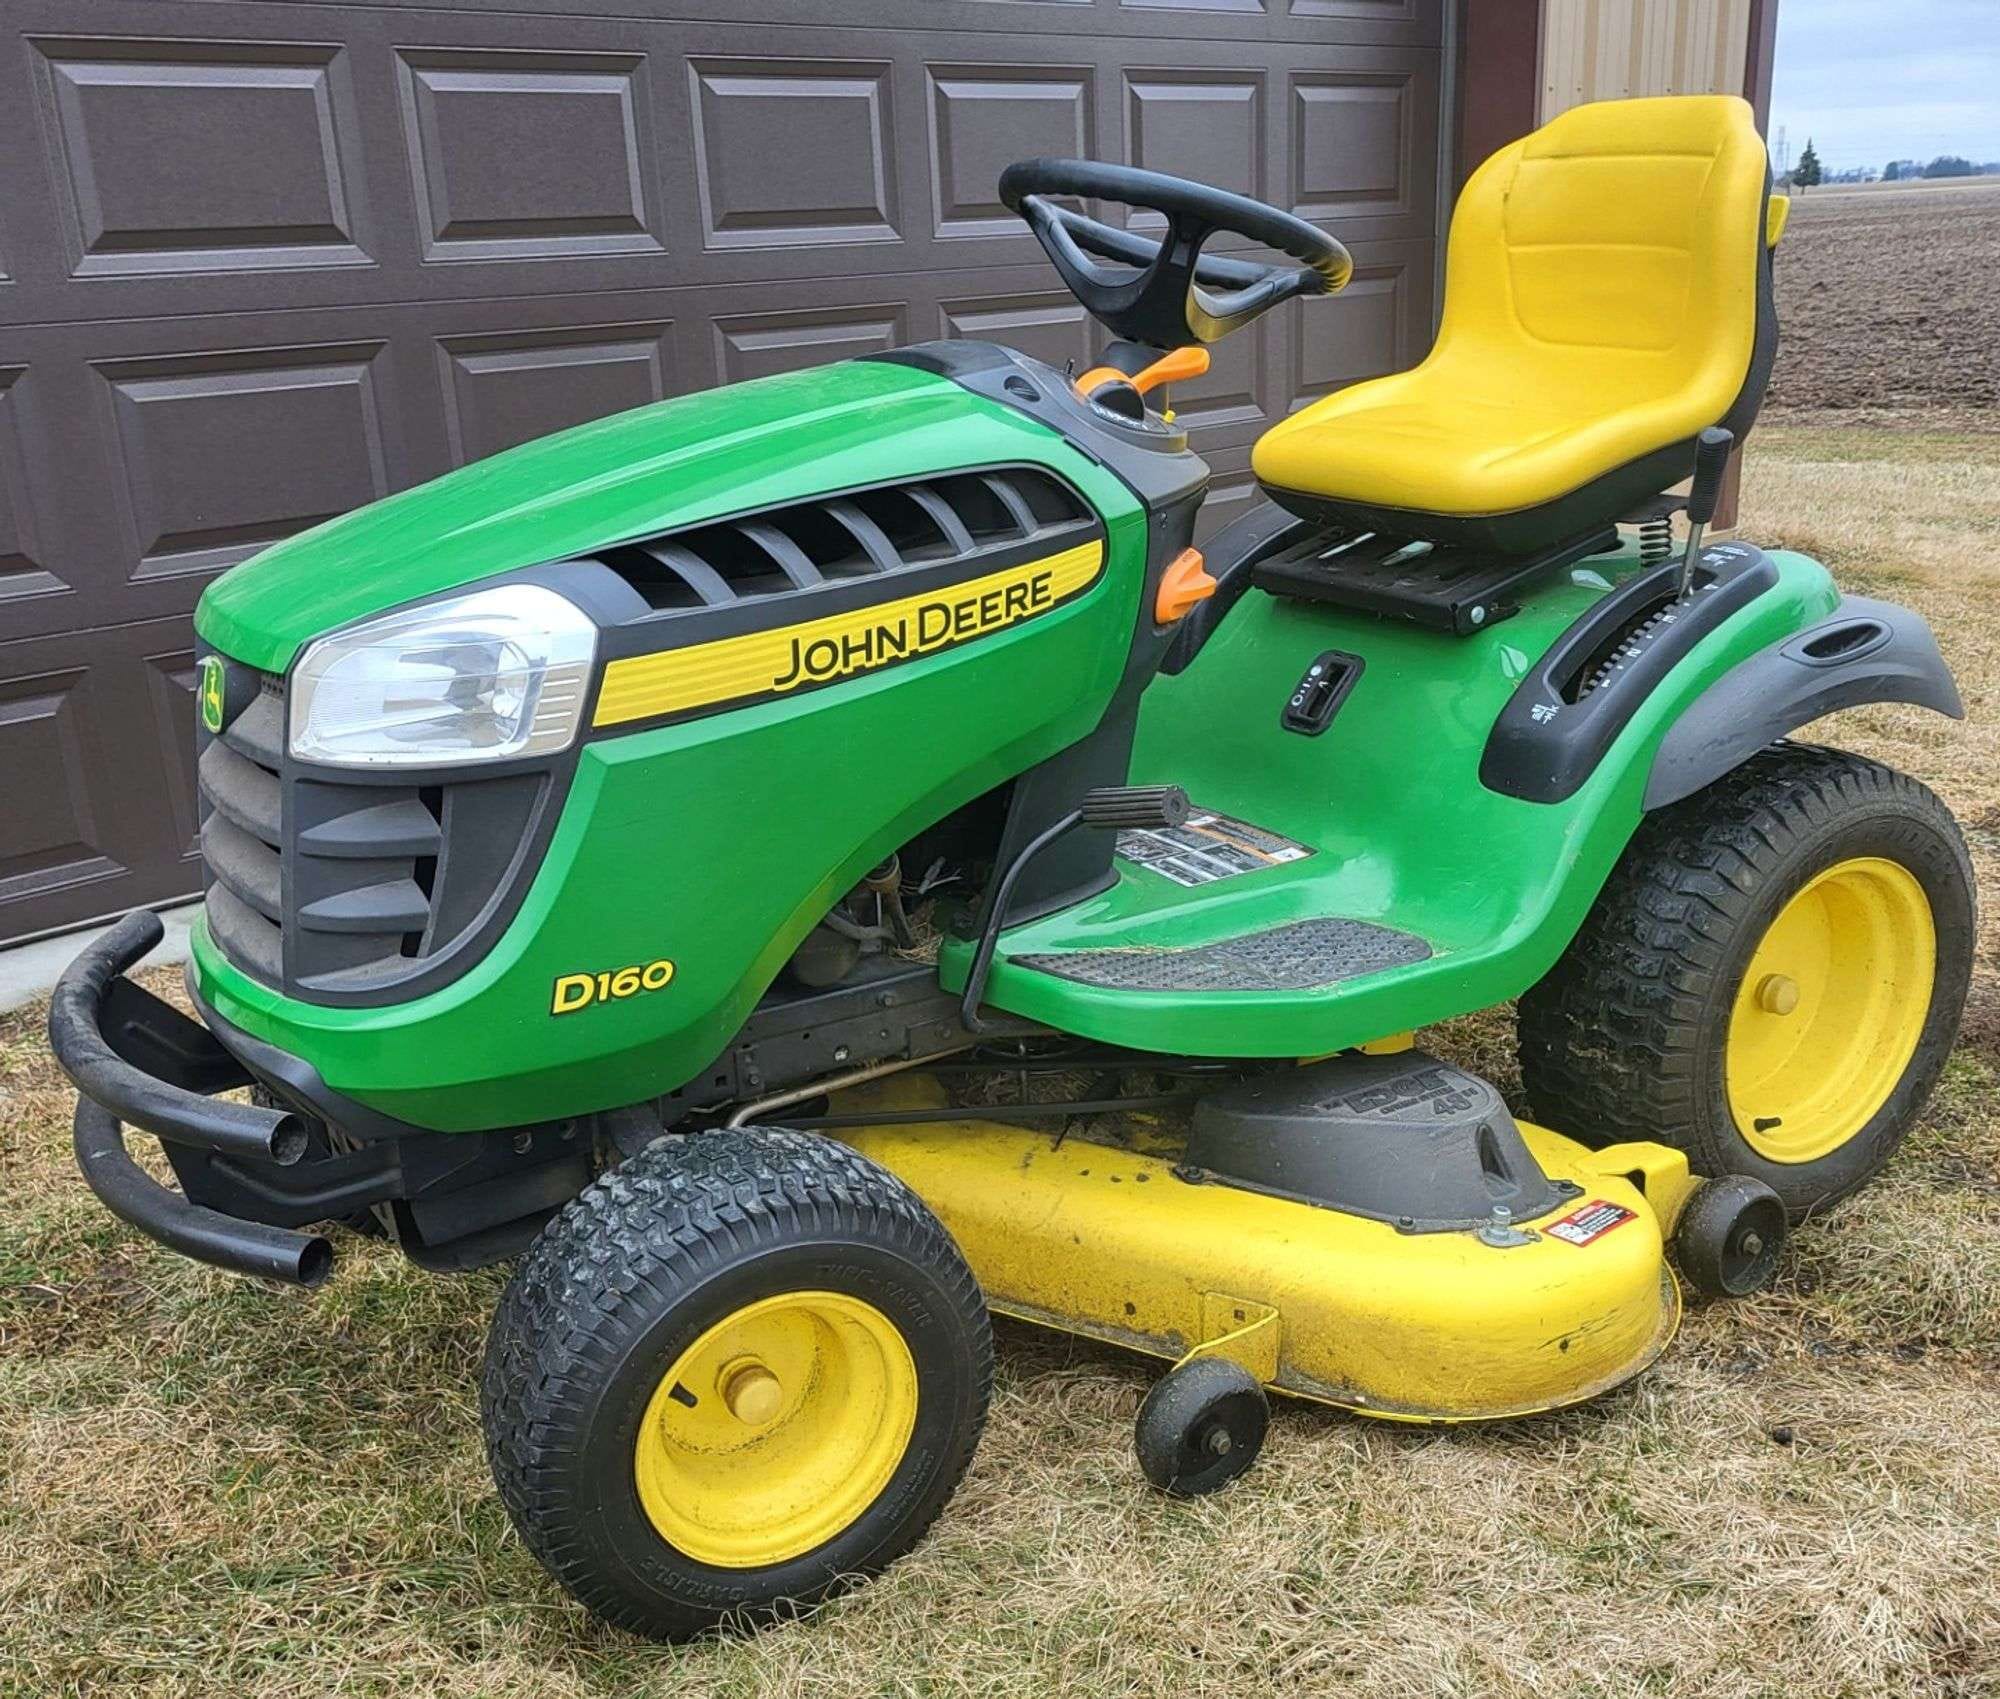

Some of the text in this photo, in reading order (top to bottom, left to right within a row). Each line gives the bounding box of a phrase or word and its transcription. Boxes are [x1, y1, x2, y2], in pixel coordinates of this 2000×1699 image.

[774, 571, 1053, 686] JOHN DEERE
[550, 958, 676, 1016] D160
